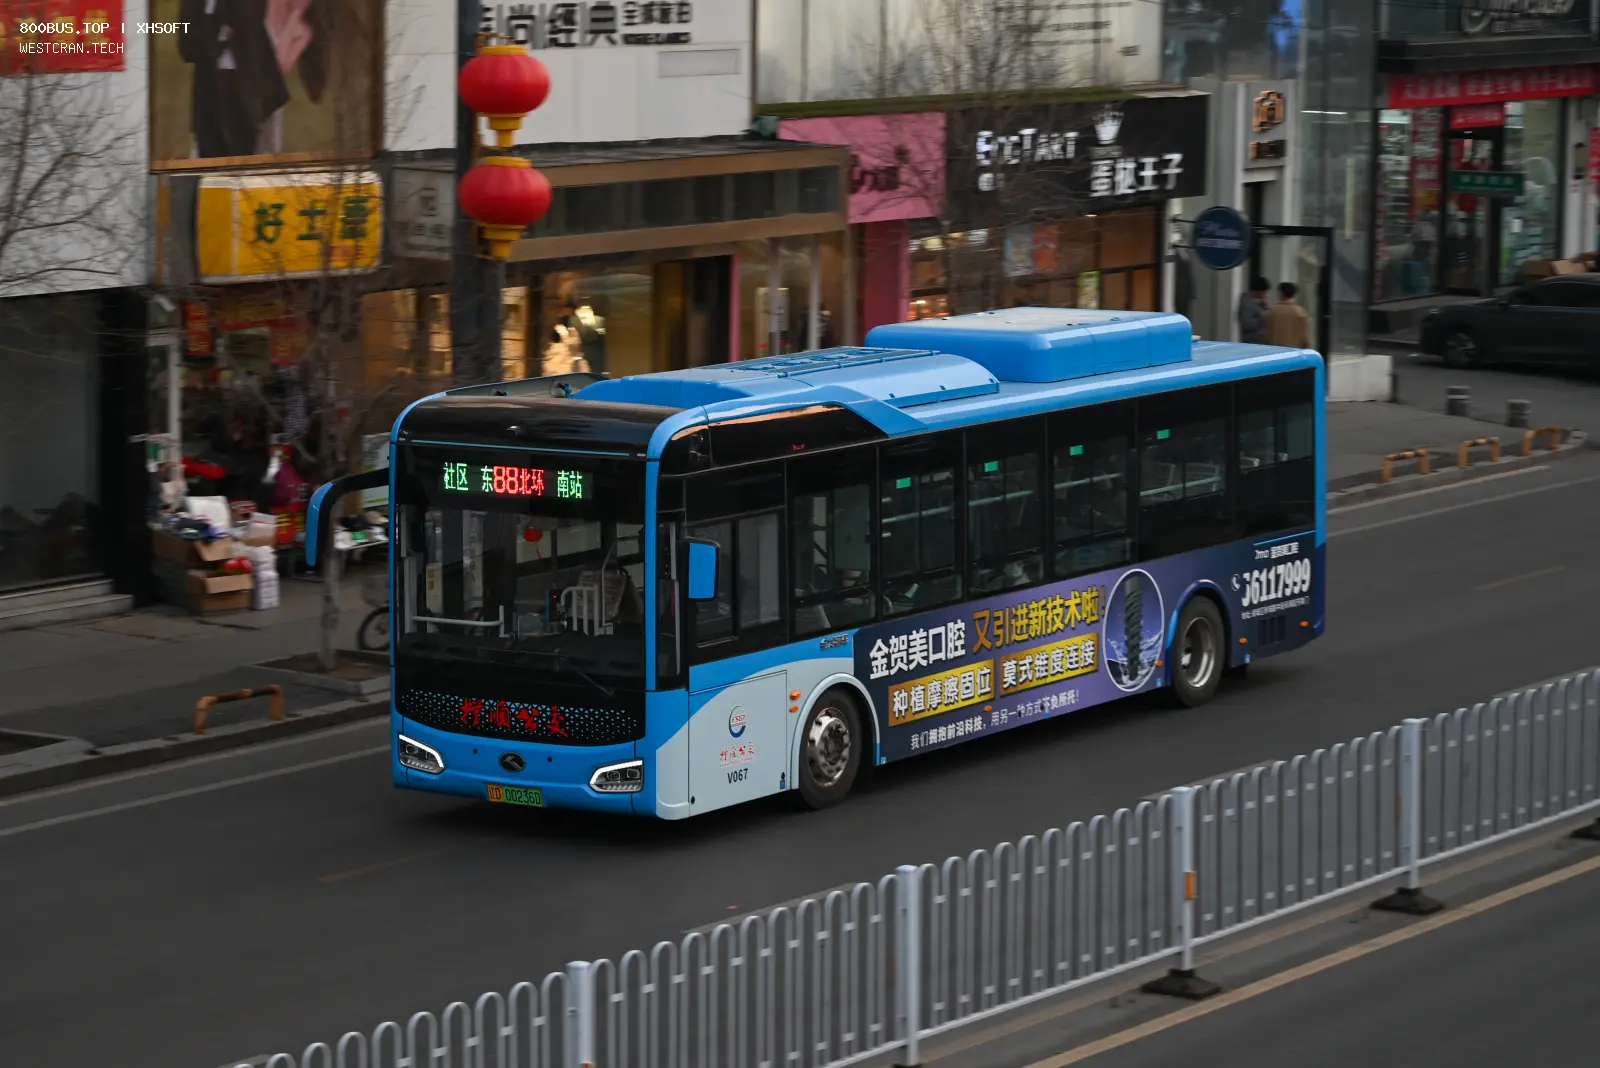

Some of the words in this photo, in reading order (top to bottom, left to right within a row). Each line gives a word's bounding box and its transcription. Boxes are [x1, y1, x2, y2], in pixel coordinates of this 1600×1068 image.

[443, 462, 469, 491] 社区
[557, 469, 583, 499] 南站
[868, 619, 966, 681] 金贺美口腔
[892, 665, 992, 719] 种植摩擦固位
[1002, 639, 1096, 690] 莫式锥度连接
[727, 768, 749, 784] V067
[504, 788, 542, 805] 00236D
